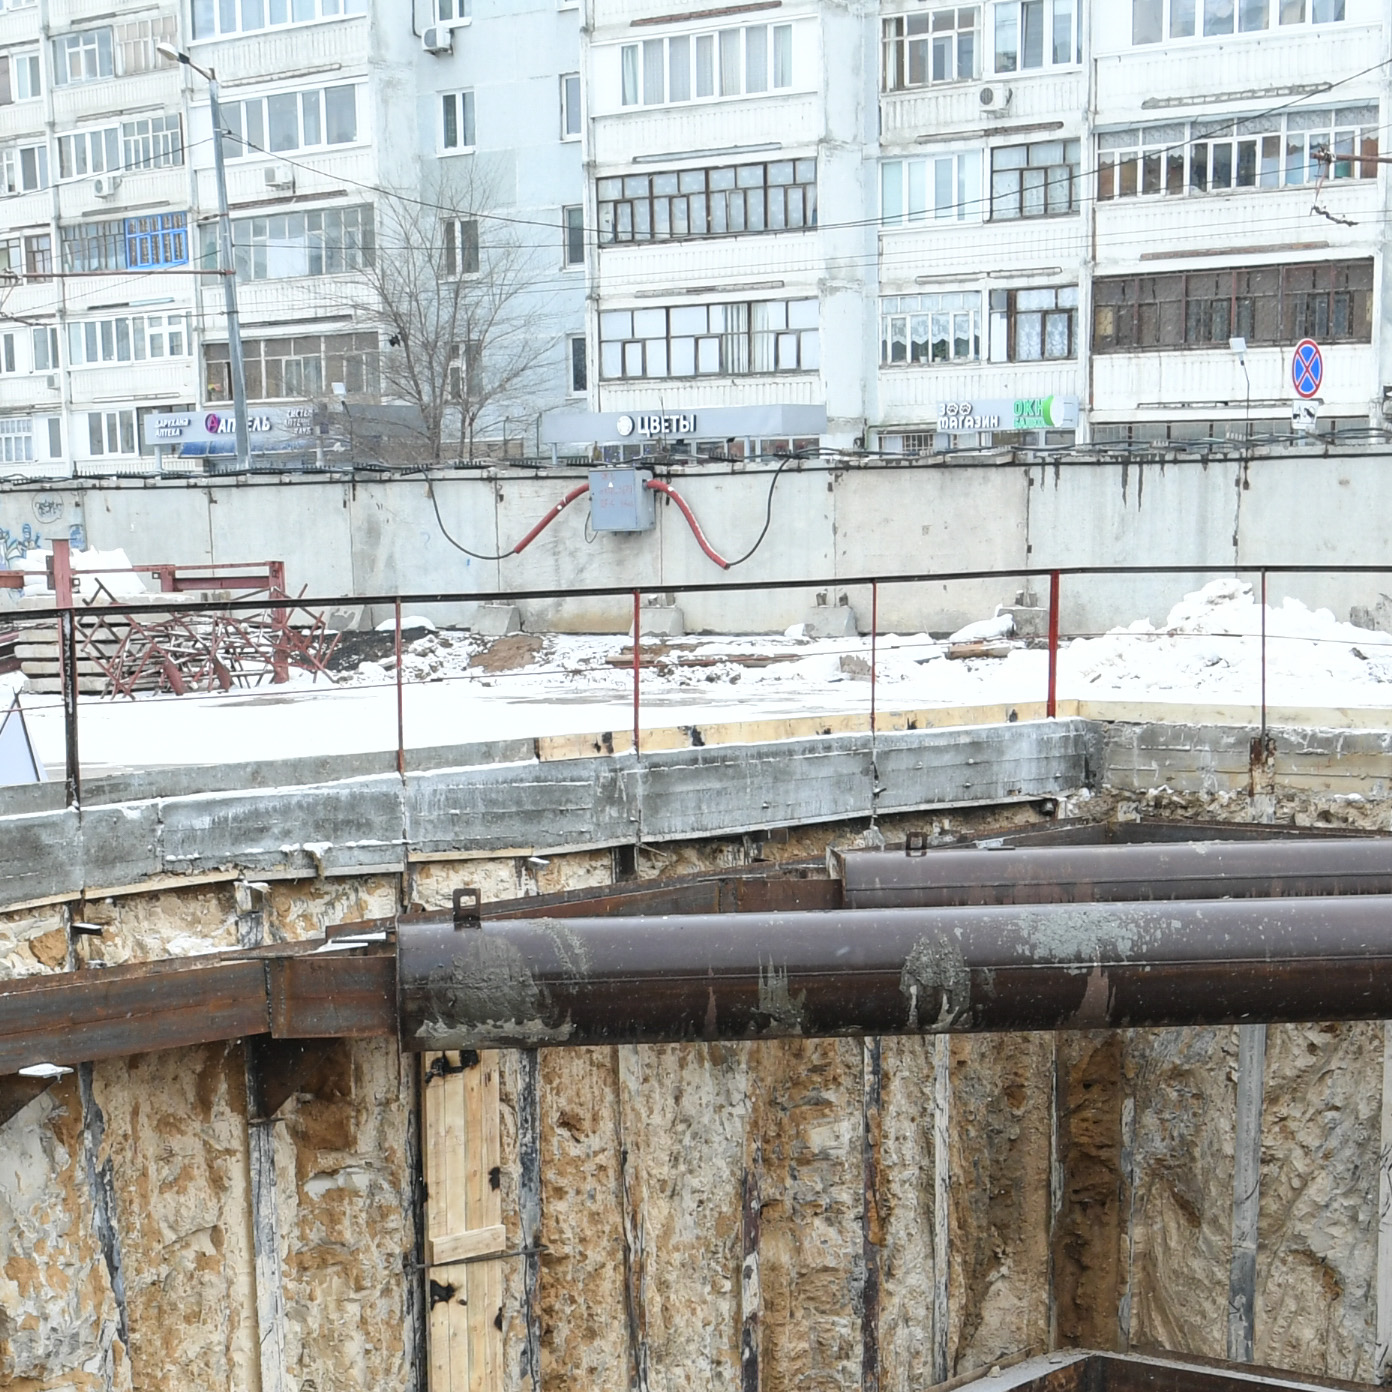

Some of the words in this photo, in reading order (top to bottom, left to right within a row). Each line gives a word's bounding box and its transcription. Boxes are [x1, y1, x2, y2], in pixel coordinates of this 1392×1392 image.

[1013, 399, 1044, 417] ОКН
[217, 416, 272, 434] АПЕЛЬ
[637, 414, 696, 438] ЦВЕТЫ
[938, 415, 999, 430] МАГАЗИН
[156, 428, 182, 437] АПТЕКА
